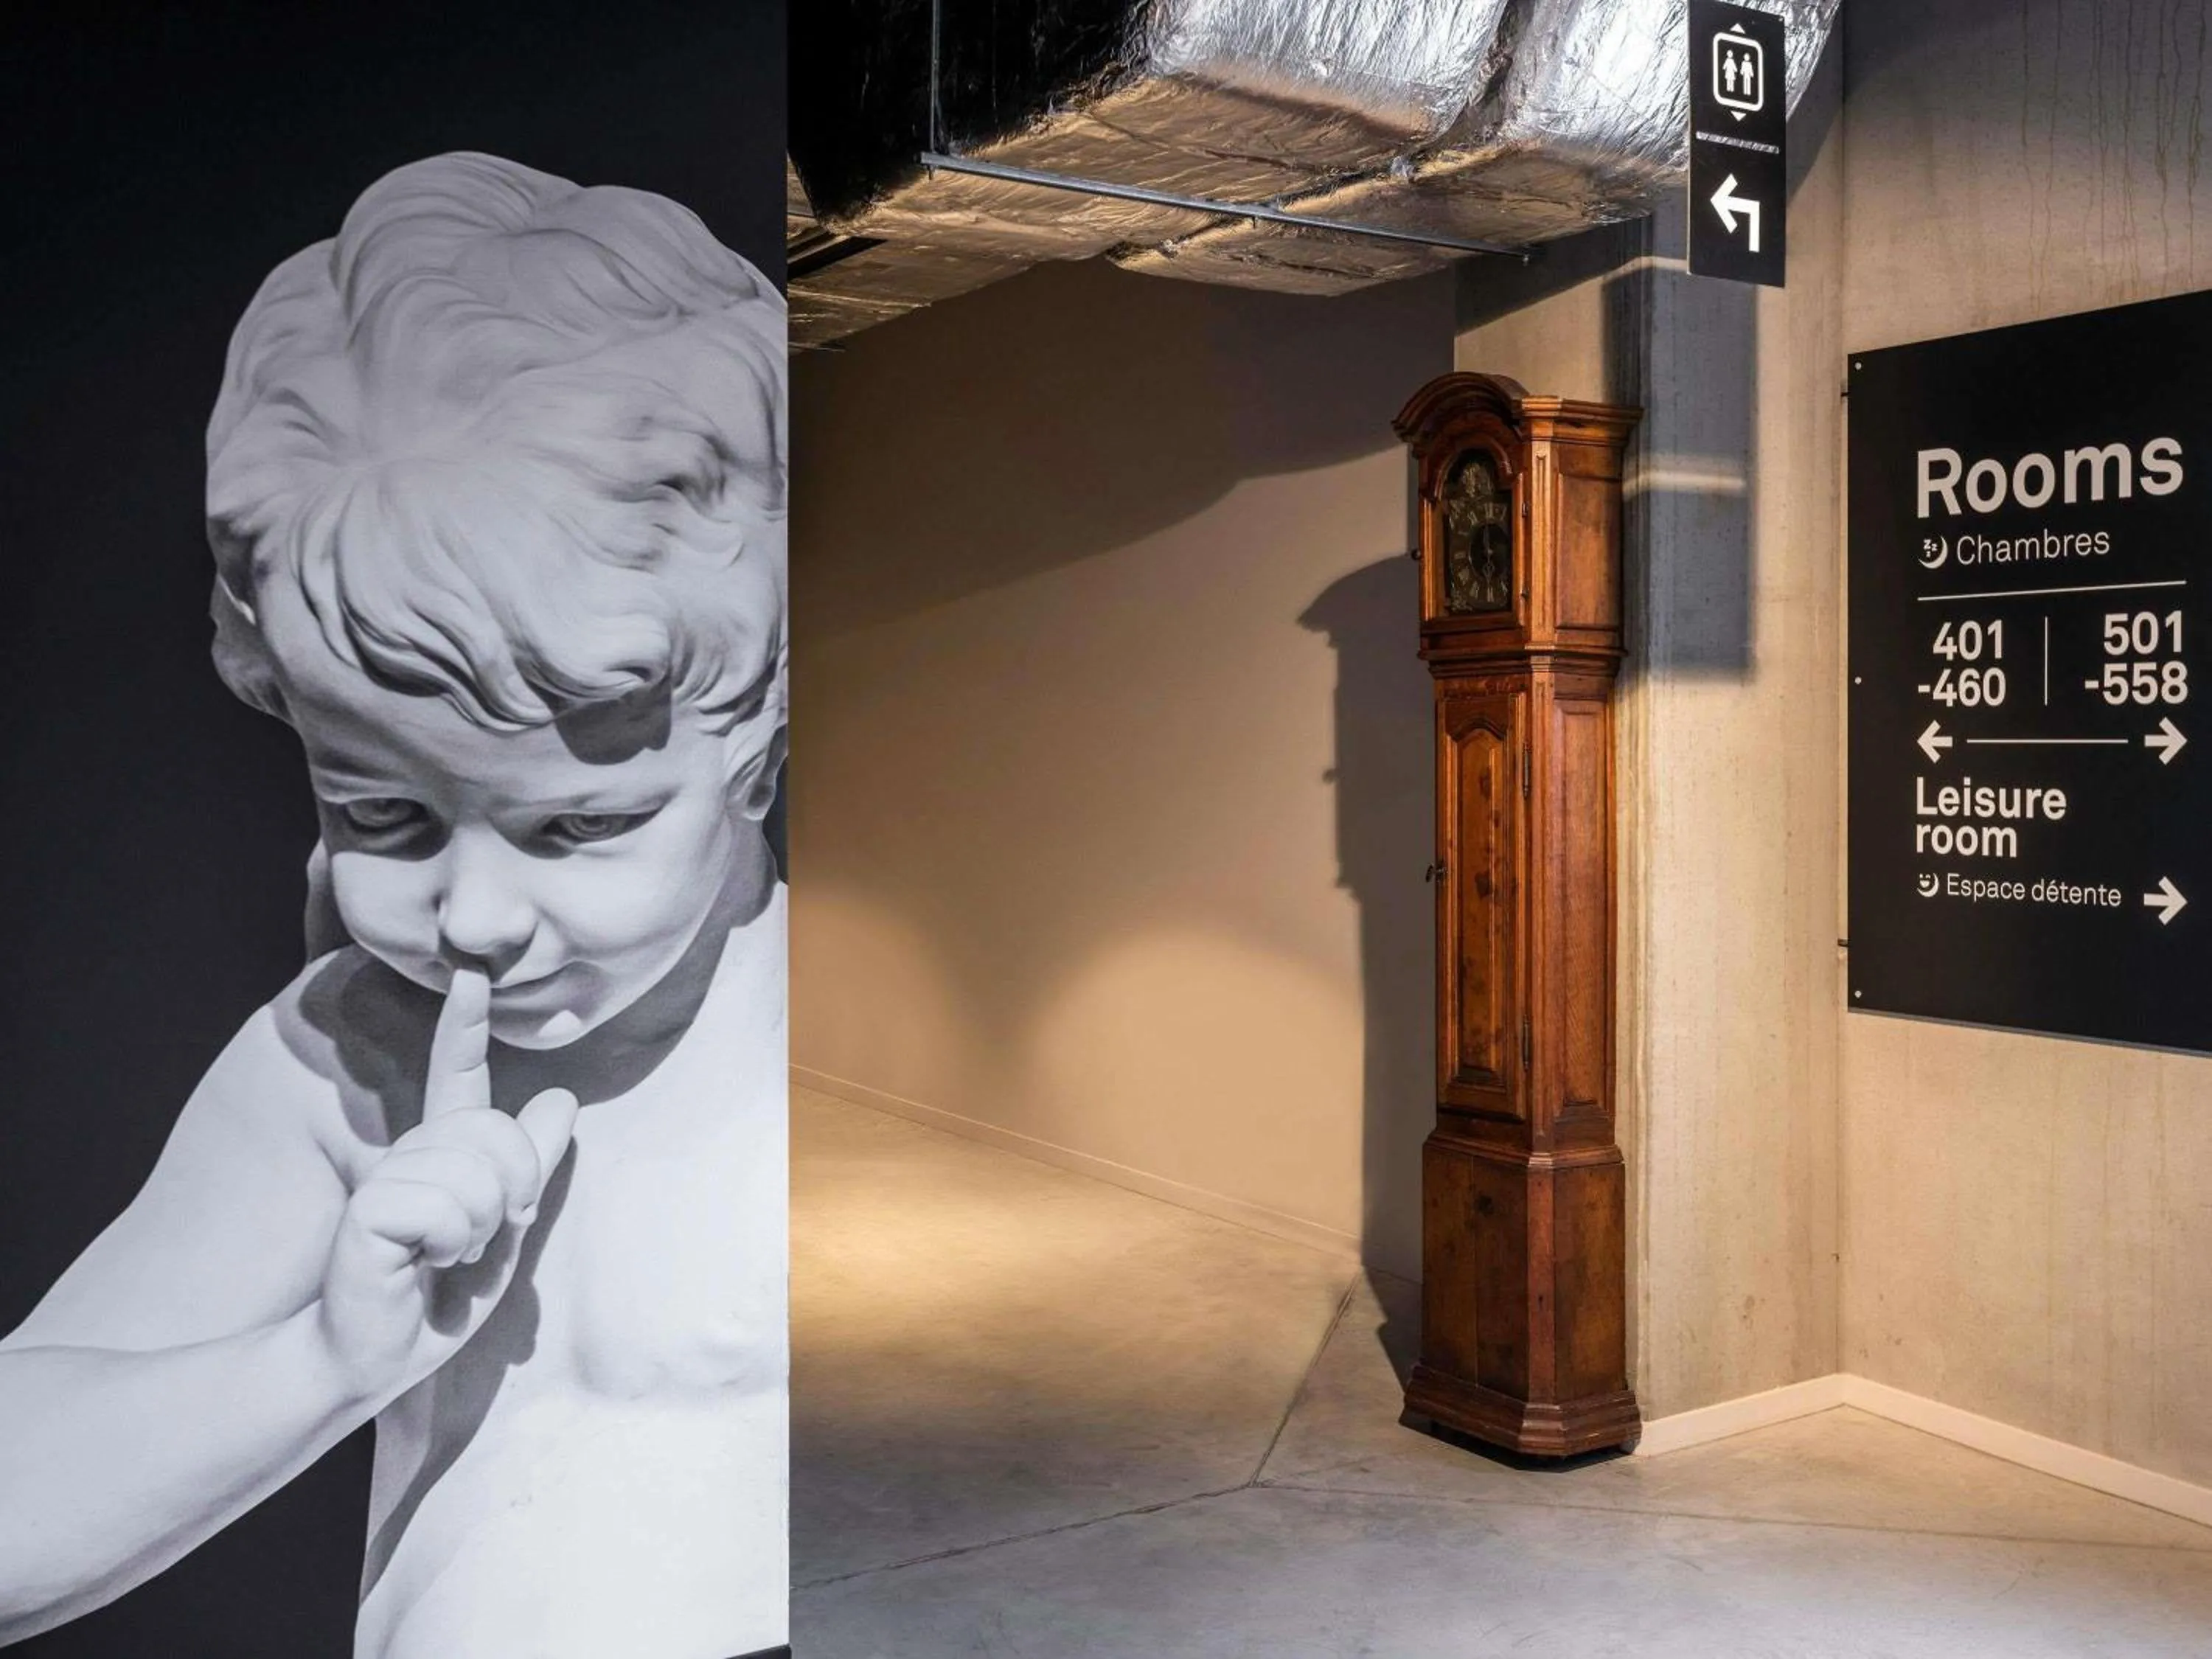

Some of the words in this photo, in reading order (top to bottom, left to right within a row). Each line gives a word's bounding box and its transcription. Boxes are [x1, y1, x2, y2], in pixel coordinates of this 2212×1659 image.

[1918, 437, 2184, 519] Rooms
[1956, 528, 2110, 566] Chambres
[1933, 619, 2003, 661] 401
[2103, 610, 2183, 655] 501
[1917, 667, 2007, 708] -460
[2084, 661, 2188, 706] -558
[1916, 776, 2067, 821] Leisure
[1916, 824, 2017, 858] room
[1947, 872, 2026, 902] Espace
[2031, 878, 2122, 908] détente
